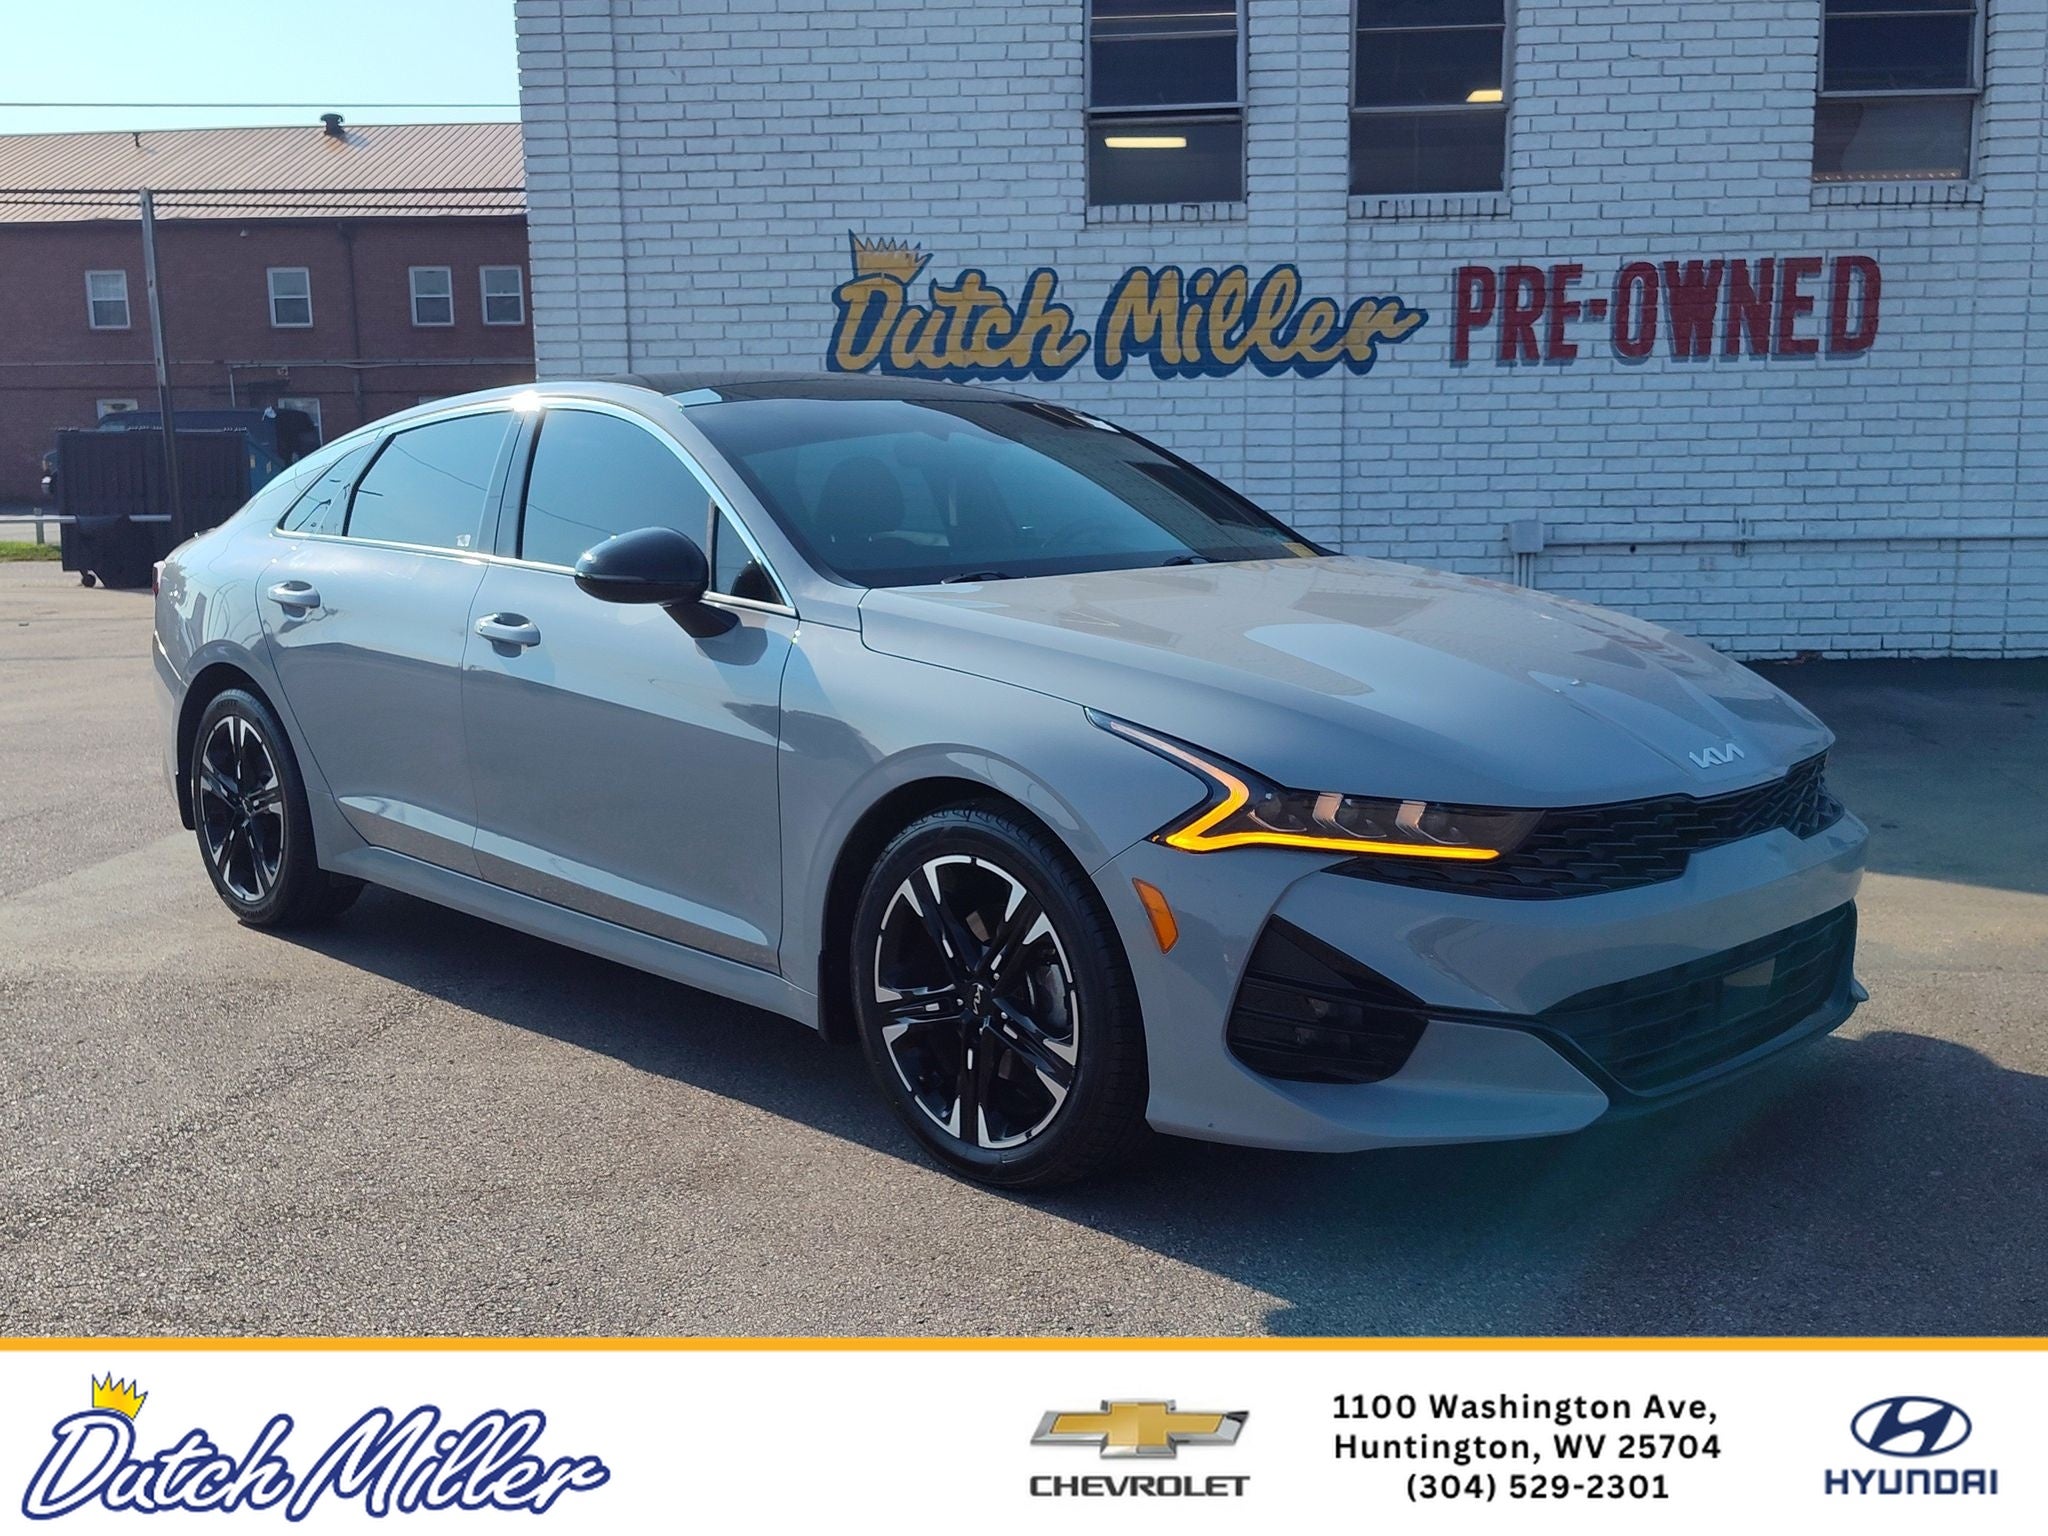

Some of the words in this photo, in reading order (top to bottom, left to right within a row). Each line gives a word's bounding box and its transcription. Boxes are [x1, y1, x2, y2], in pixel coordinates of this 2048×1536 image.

[826, 268, 1091, 384] Dutch
[1096, 264, 1428, 381] Miller
[1450, 255, 1882, 368] PRE-OWNED
